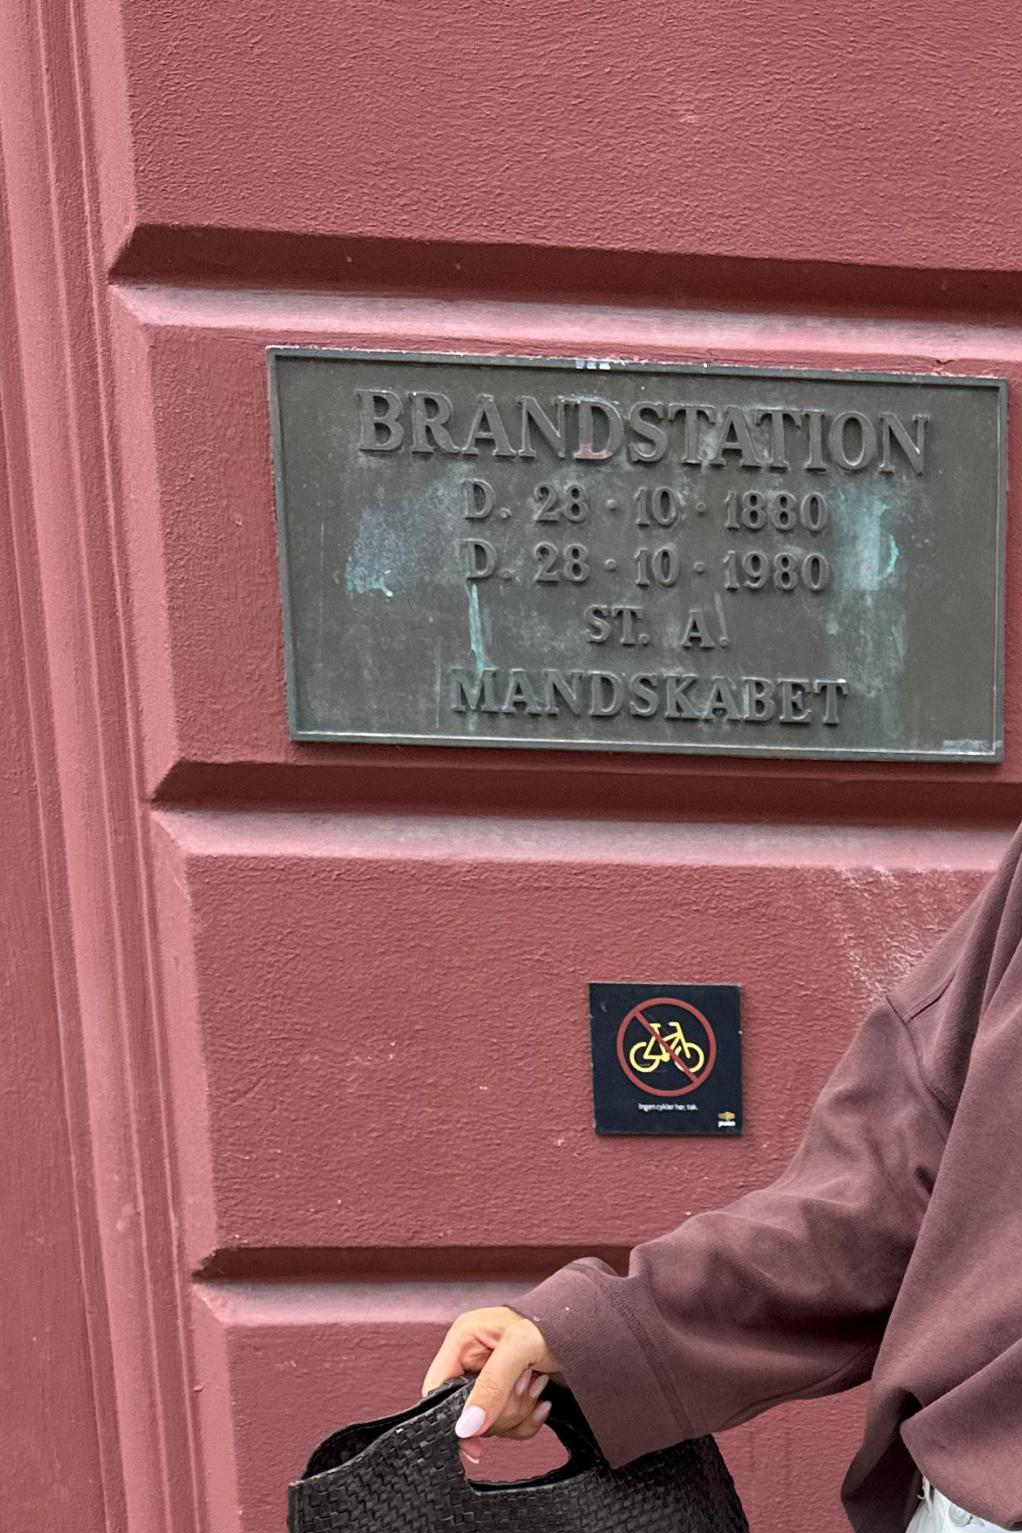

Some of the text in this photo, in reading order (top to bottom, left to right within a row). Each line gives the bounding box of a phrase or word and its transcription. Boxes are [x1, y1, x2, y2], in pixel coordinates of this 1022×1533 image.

[357, 388, 930, 476] BRANDSTATION
[462, 478, 512, 520] D.
[533, 482, 589, 523] 28
[633, 486, 680, 527] 10
[723, 490, 829, 532] 1880
[462, 538, 513, 580] D.
[533, 542, 590, 583] 28
[633, 547, 681, 587] 10
[722, 550, 831, 592] 1980
[583, 604, 650, 646] ST.
[449, 666, 850, 726] MANDSKABET
